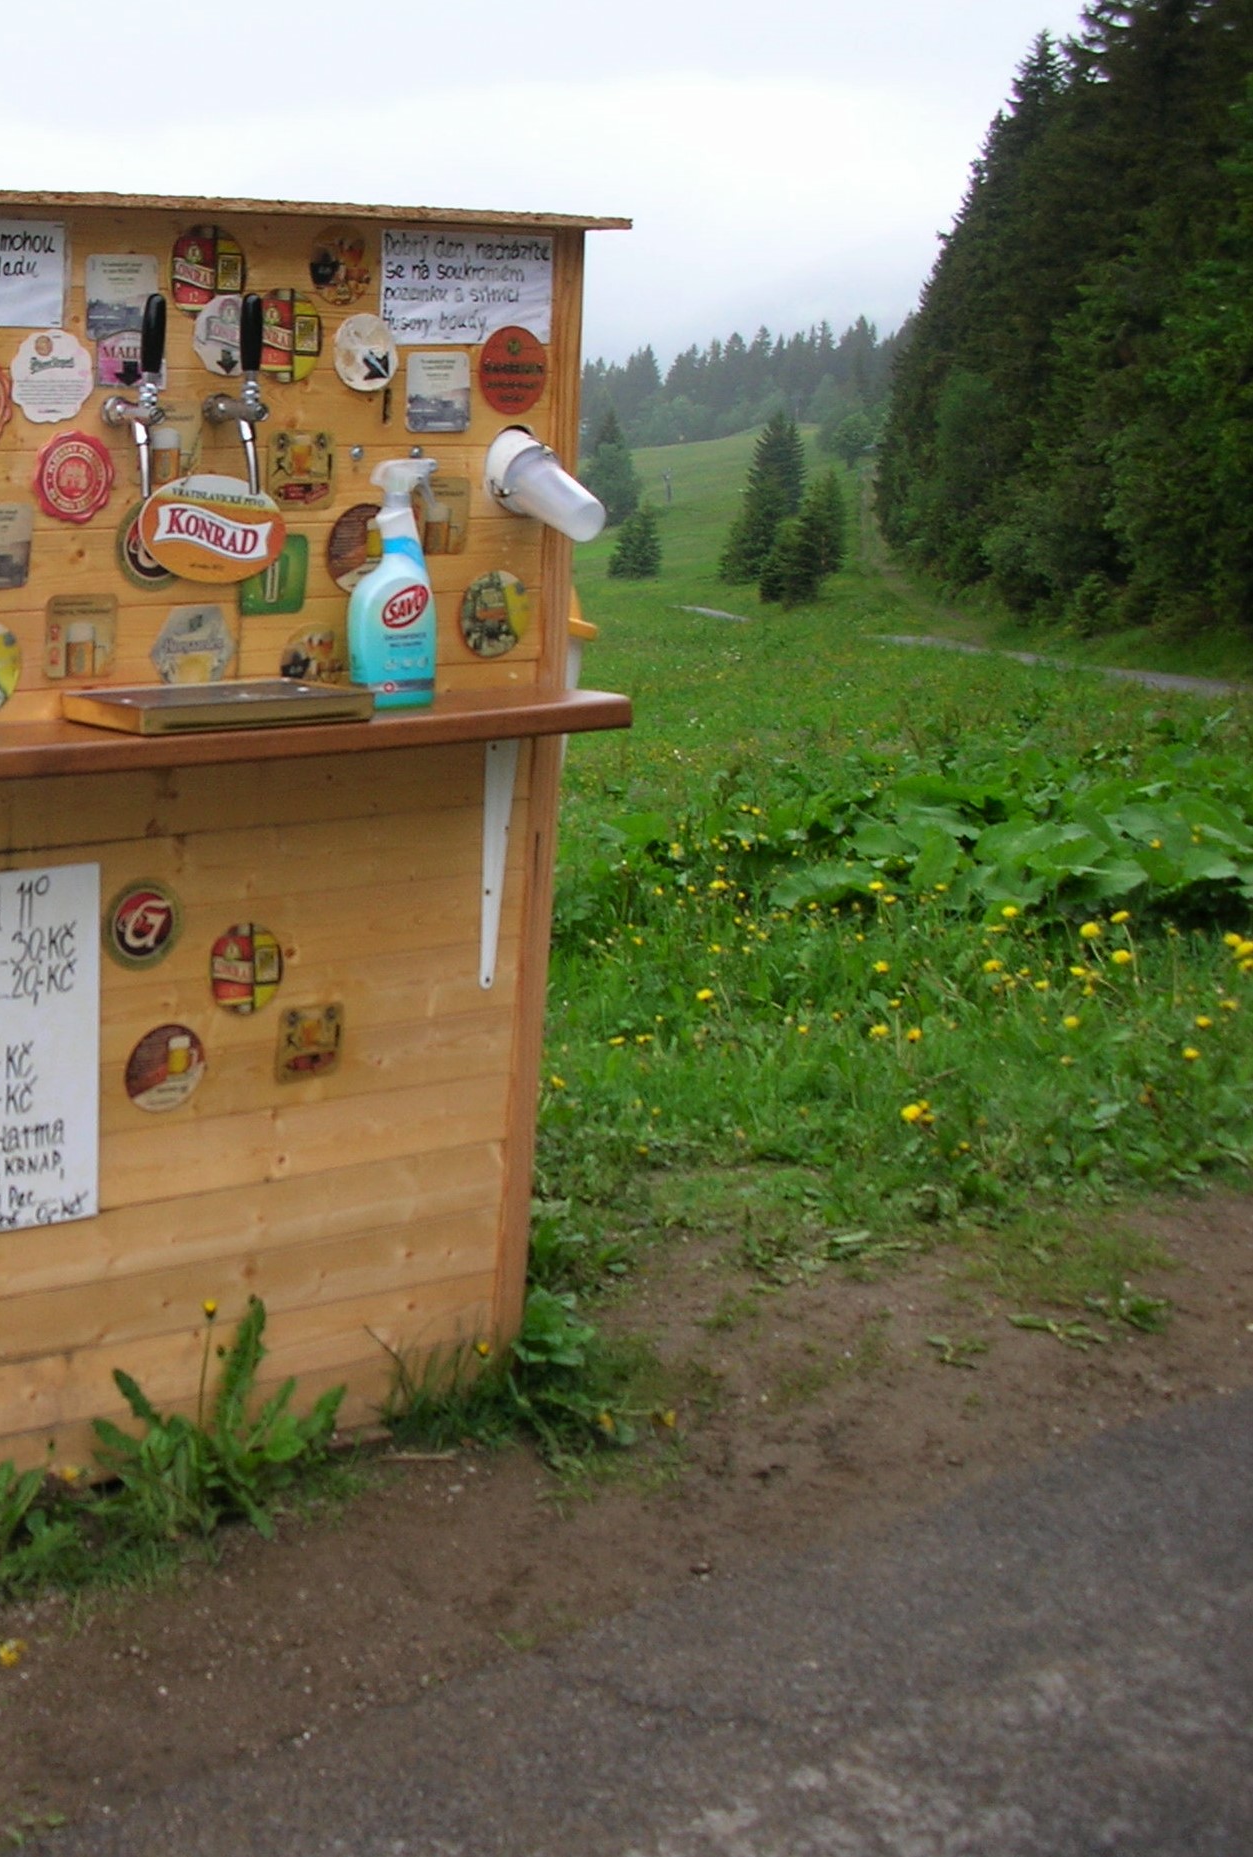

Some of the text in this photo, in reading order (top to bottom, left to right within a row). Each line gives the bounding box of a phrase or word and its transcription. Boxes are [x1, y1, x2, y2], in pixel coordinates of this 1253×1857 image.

[0, 230, 56, 254] mohou
[384, 232, 430, 262] Dobrý
[455, 286, 464, 302] a
[165, 507, 260, 555] KONRAD
[386, 590, 426, 621] SAVO
